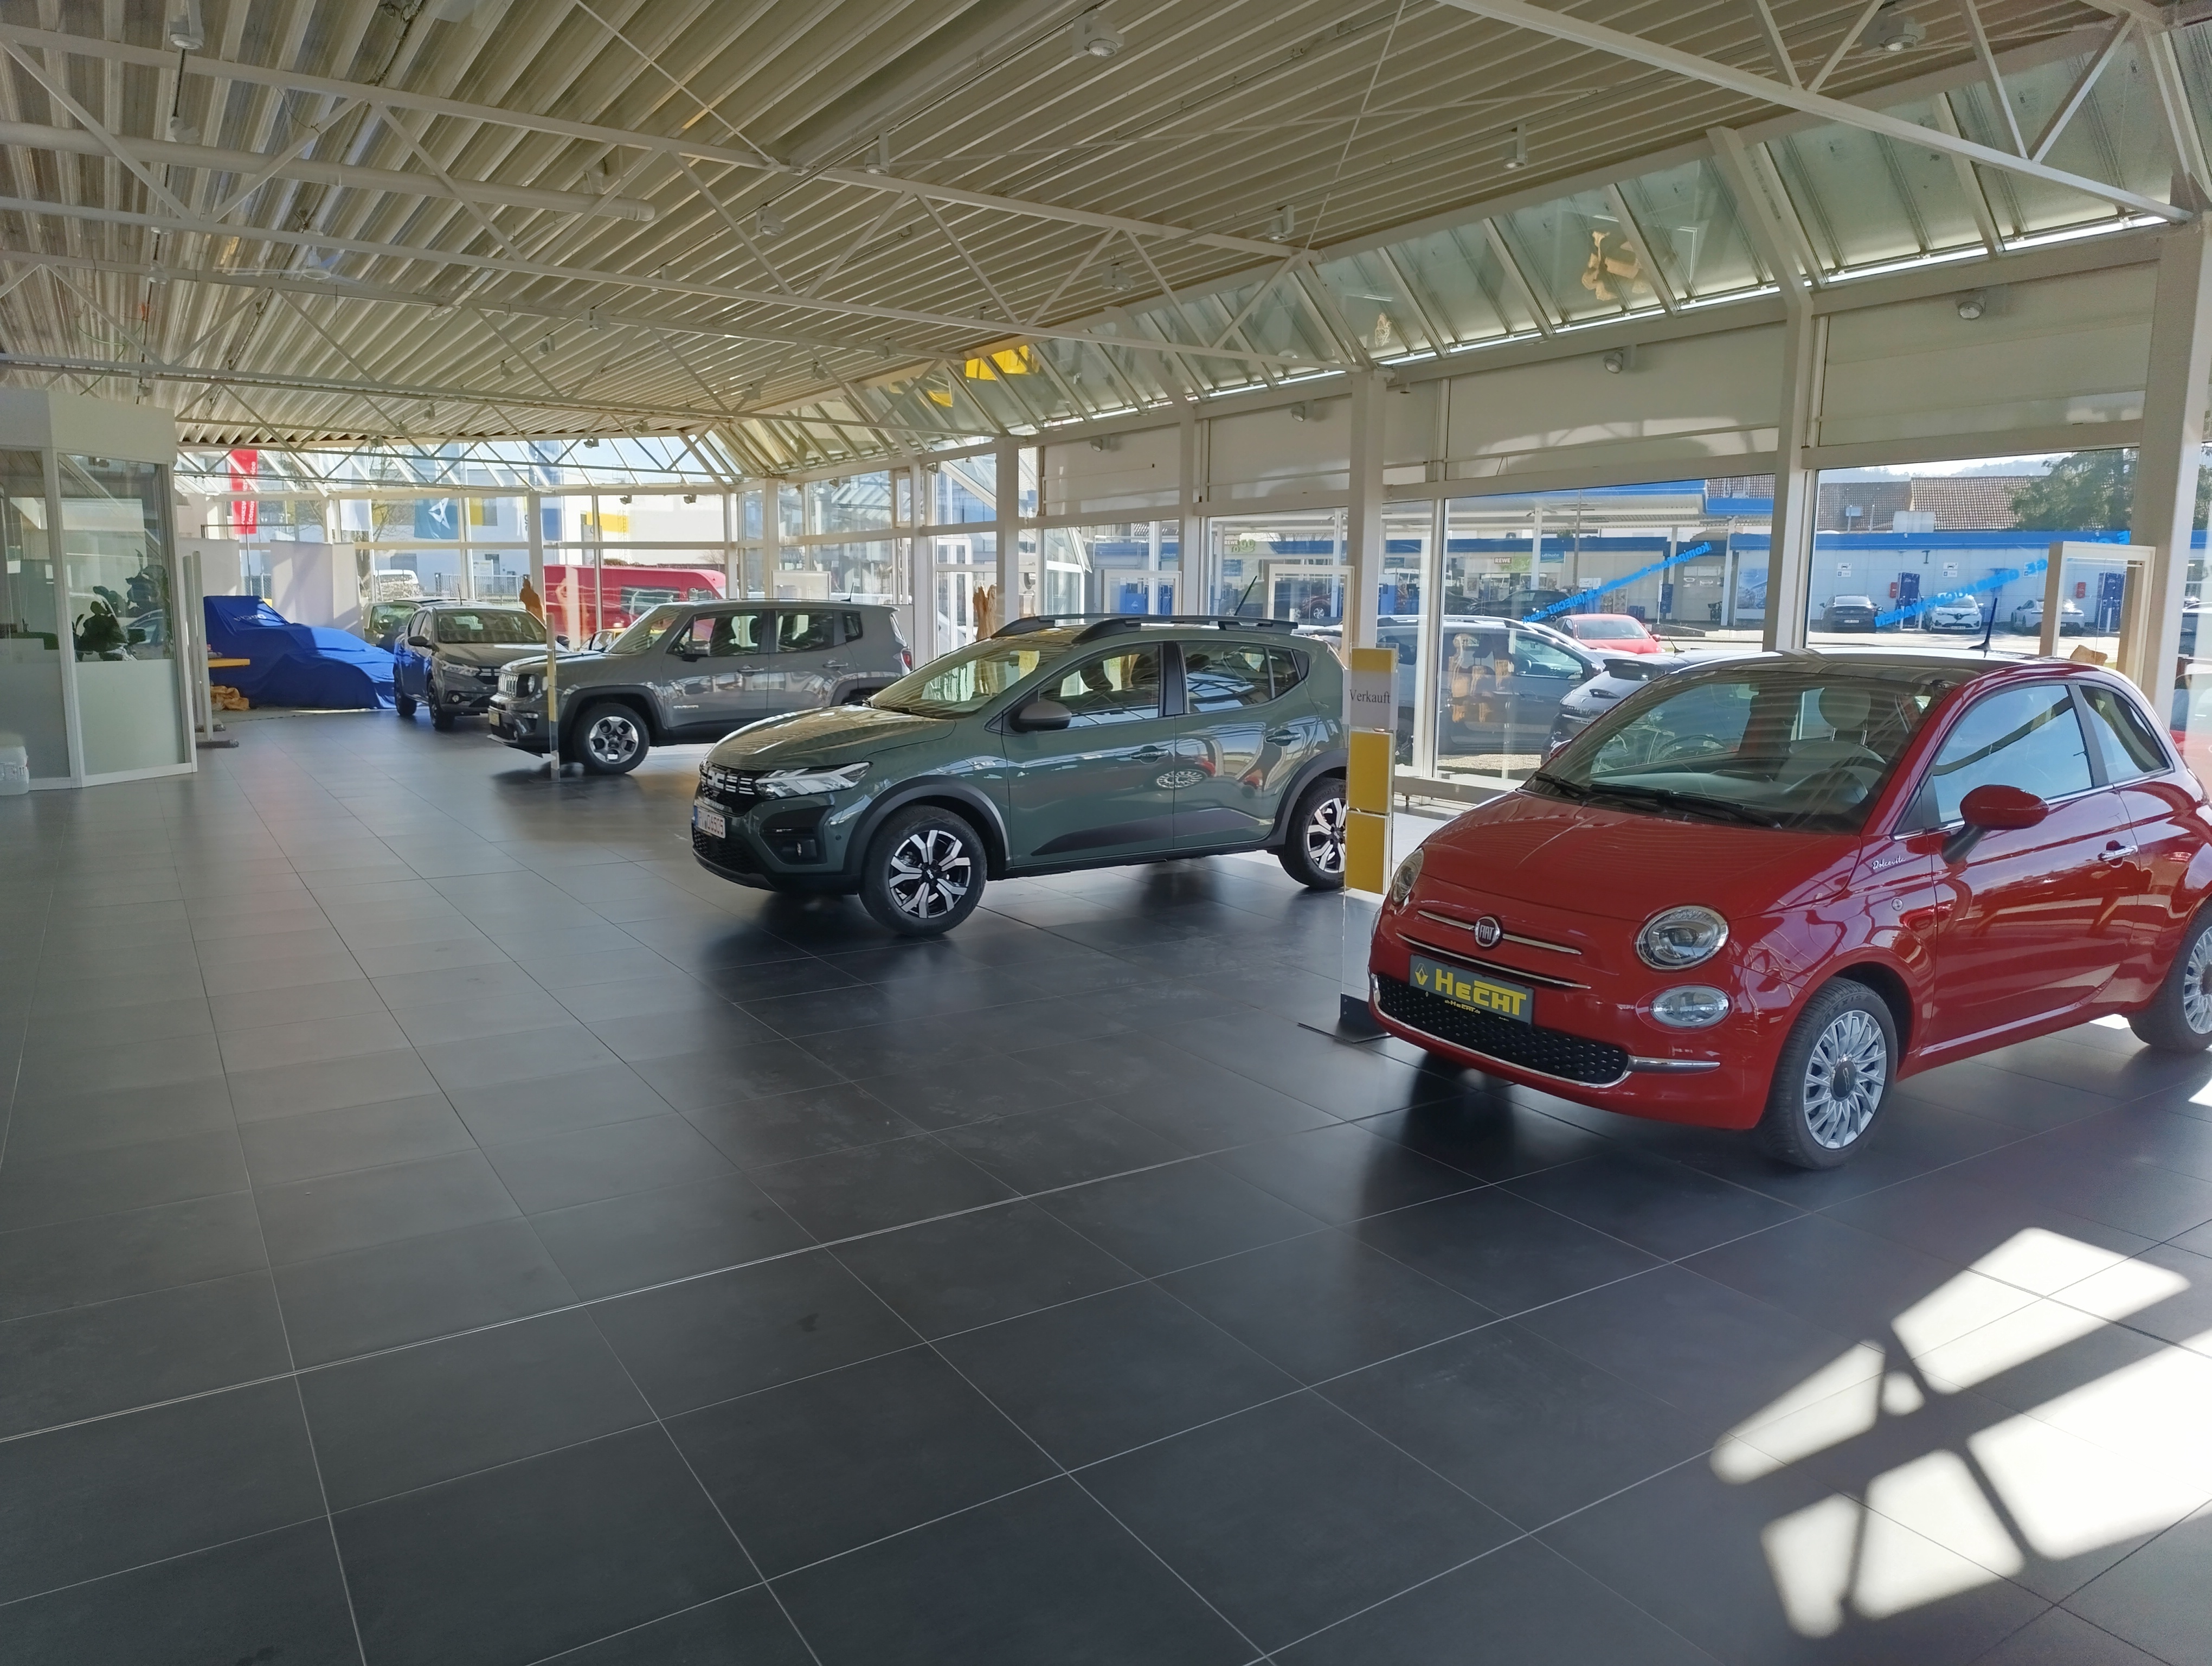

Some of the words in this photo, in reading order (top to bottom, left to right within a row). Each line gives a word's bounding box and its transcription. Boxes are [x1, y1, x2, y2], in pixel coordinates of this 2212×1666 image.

[1349, 689, 1391, 704] Verkauft
[1873, 855, 1906, 870] Dolcevita
[1479, 924, 1495, 941] FIAT
